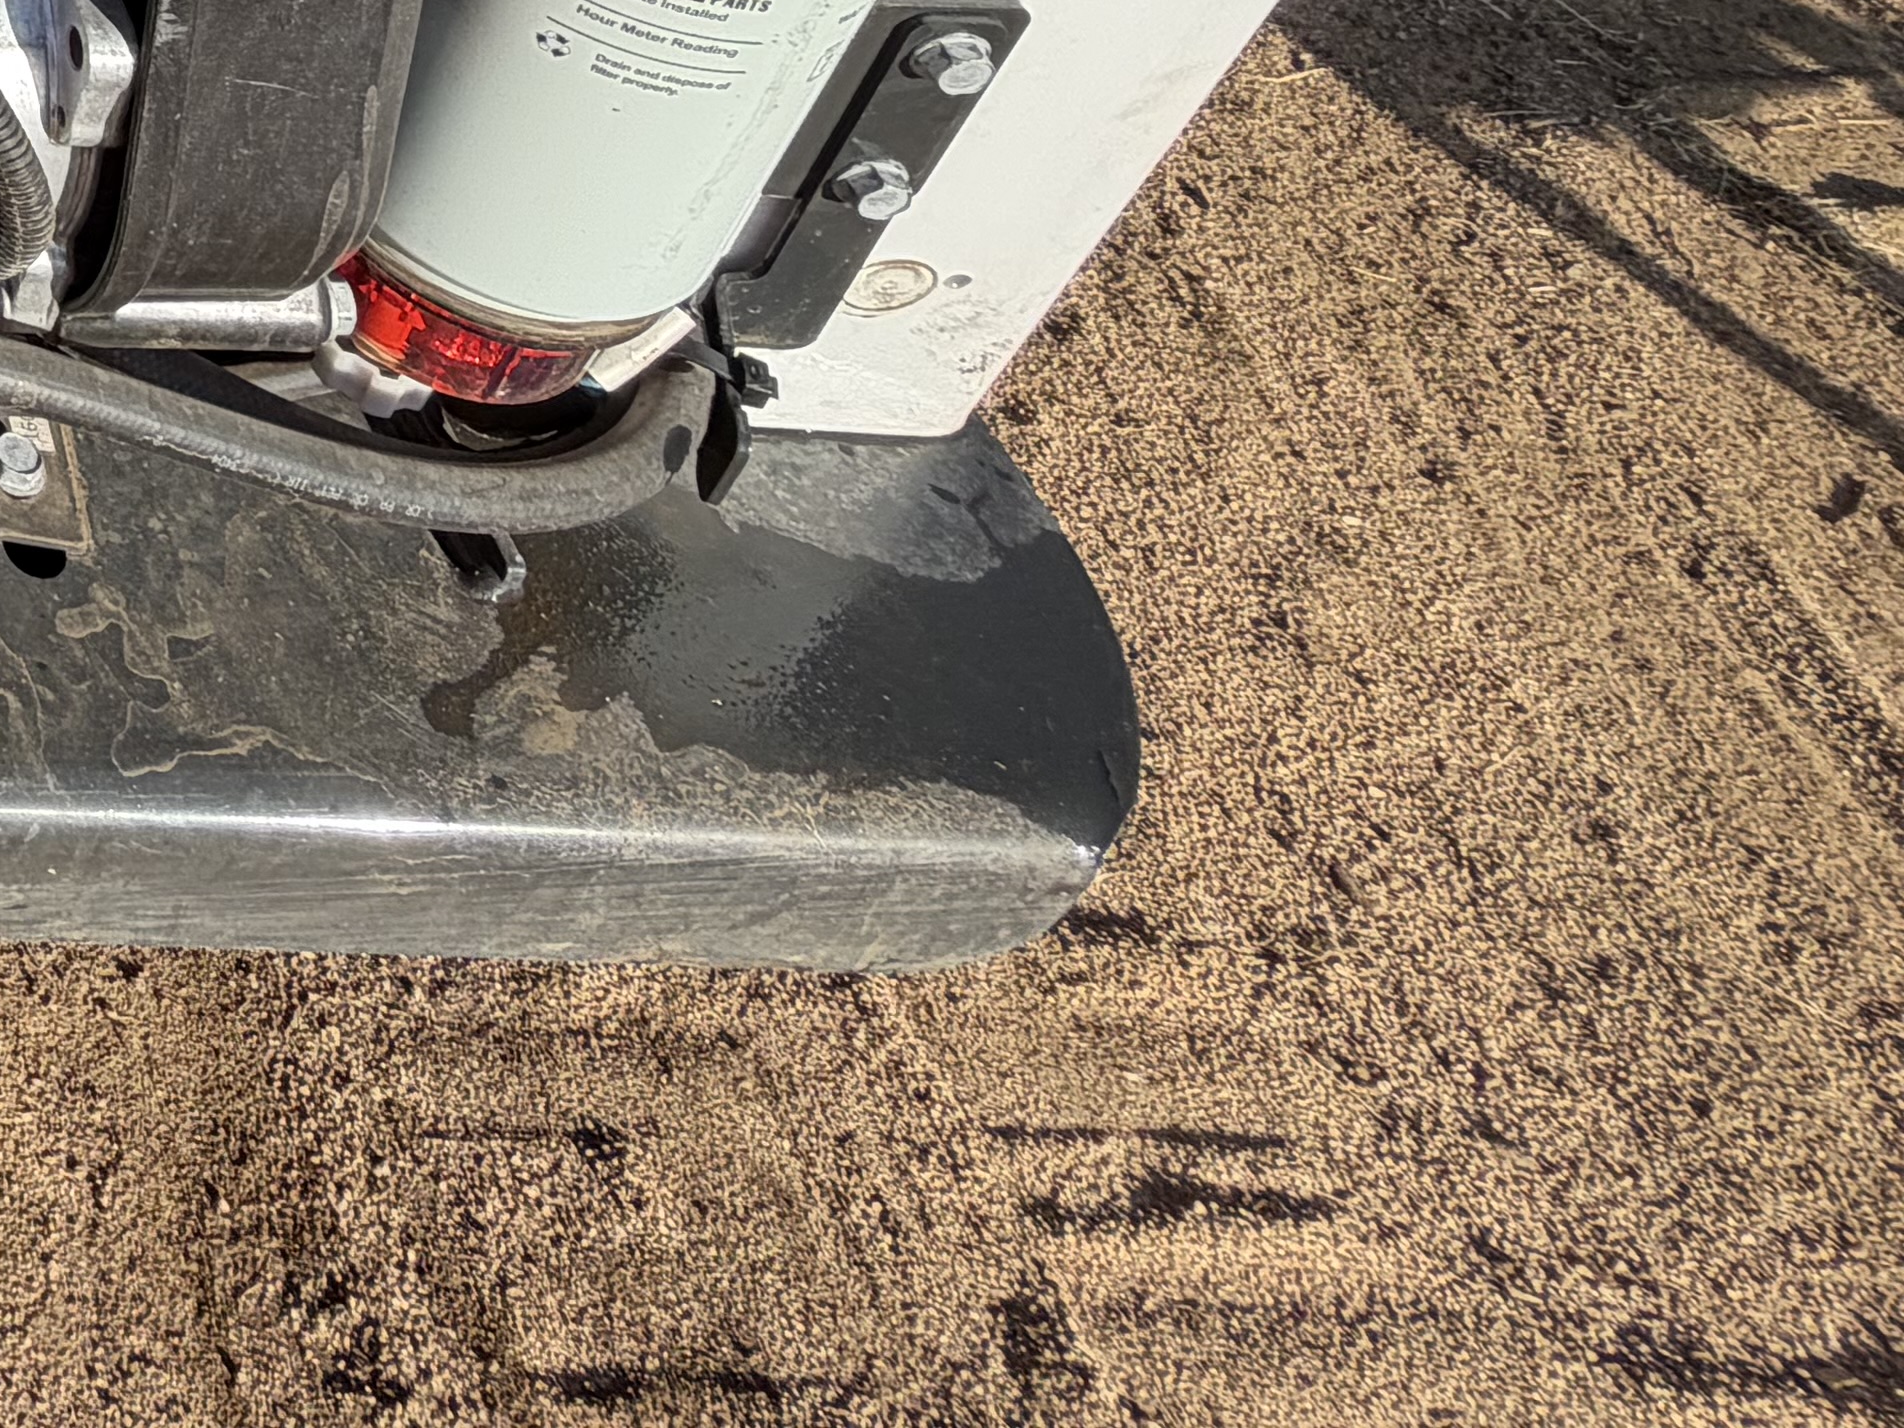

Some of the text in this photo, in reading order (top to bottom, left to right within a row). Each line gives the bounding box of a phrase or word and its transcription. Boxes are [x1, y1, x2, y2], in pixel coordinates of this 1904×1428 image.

[575, 2, 739, 59] Hour Meter Reading
[589, 63, 620, 81] filter
[594, 53, 733, 91] Drain and dispose of
